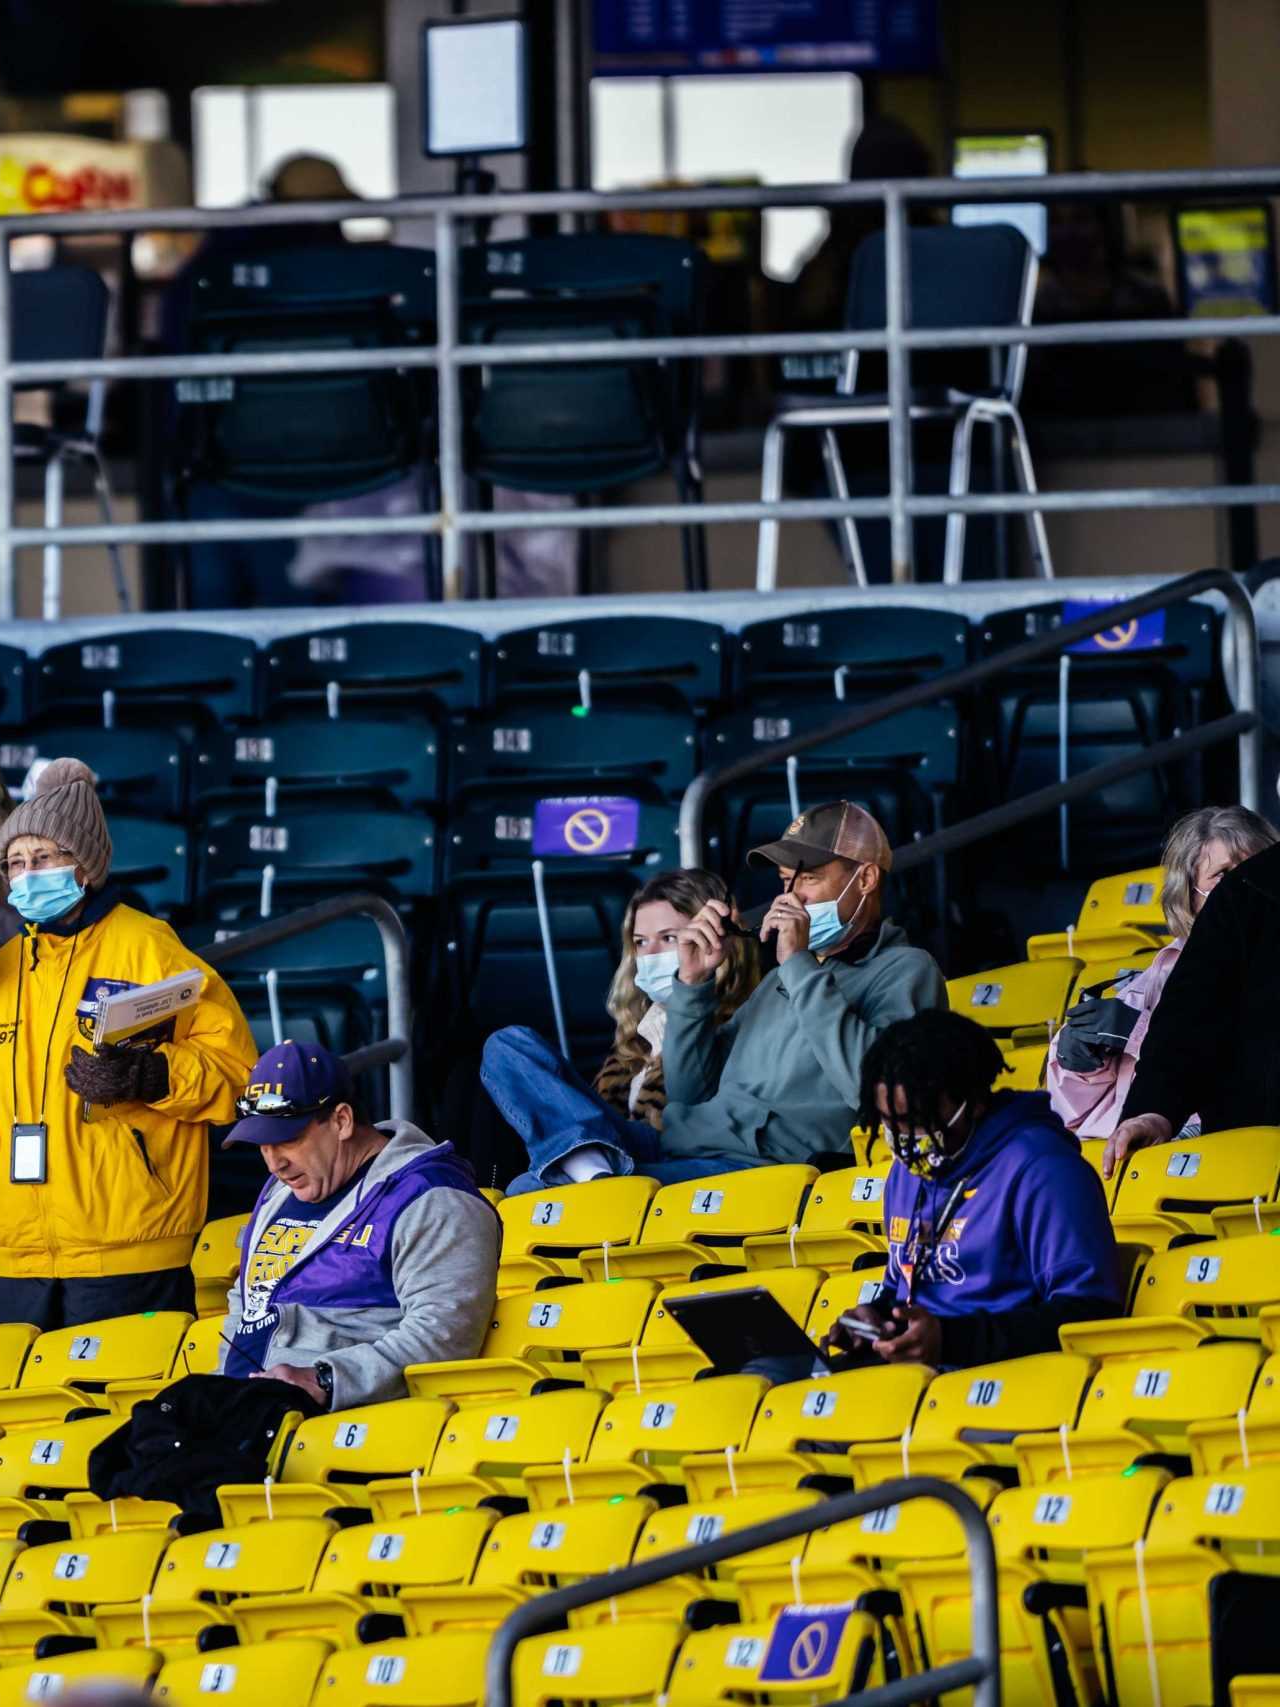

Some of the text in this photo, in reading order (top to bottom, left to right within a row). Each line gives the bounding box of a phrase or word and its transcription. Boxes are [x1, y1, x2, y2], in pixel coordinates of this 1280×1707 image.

[1135, 885, 1143, 903] 1
[981, 985, 992, 1005] 2
[1180, 1155, 1190, 1175] 7
[863, 1179, 874, 1200] 5
[702, 1192, 712, 1212] 4
[542, 1203, 552, 1224] 3
[1198, 1258, 1209, 1281] 9
[873, 1283, 882, 1302] 7
[540, 1305, 551, 1326] 5
[79, 1338, 90, 1359] 2
[976, 1381, 995, 1404] 10
[1145, 1373, 1159, 1394] 11
[814, 1392, 826, 1415] 9
[653, 1404, 664, 1427] 8
[345, 1425, 357, 1446] 6
[497, 1417, 508, 1439] 7
[42, 1442, 53, 1462] 4
[1043, 1498, 1063, 1522] 12
[1216, 1488, 1235, 1512] 13
[872, 1507, 889, 1531] 11
[541, 1524, 554, 1547] 9
[695, 1518, 717, 1545] 10
[218, 1544, 230, 1566] 7
[380, 1536, 392, 1558] 8
[65, 1556, 77, 1578] 6
[211, 1669, 222, 1691] 9
[376, 1658, 394, 1683] 10
